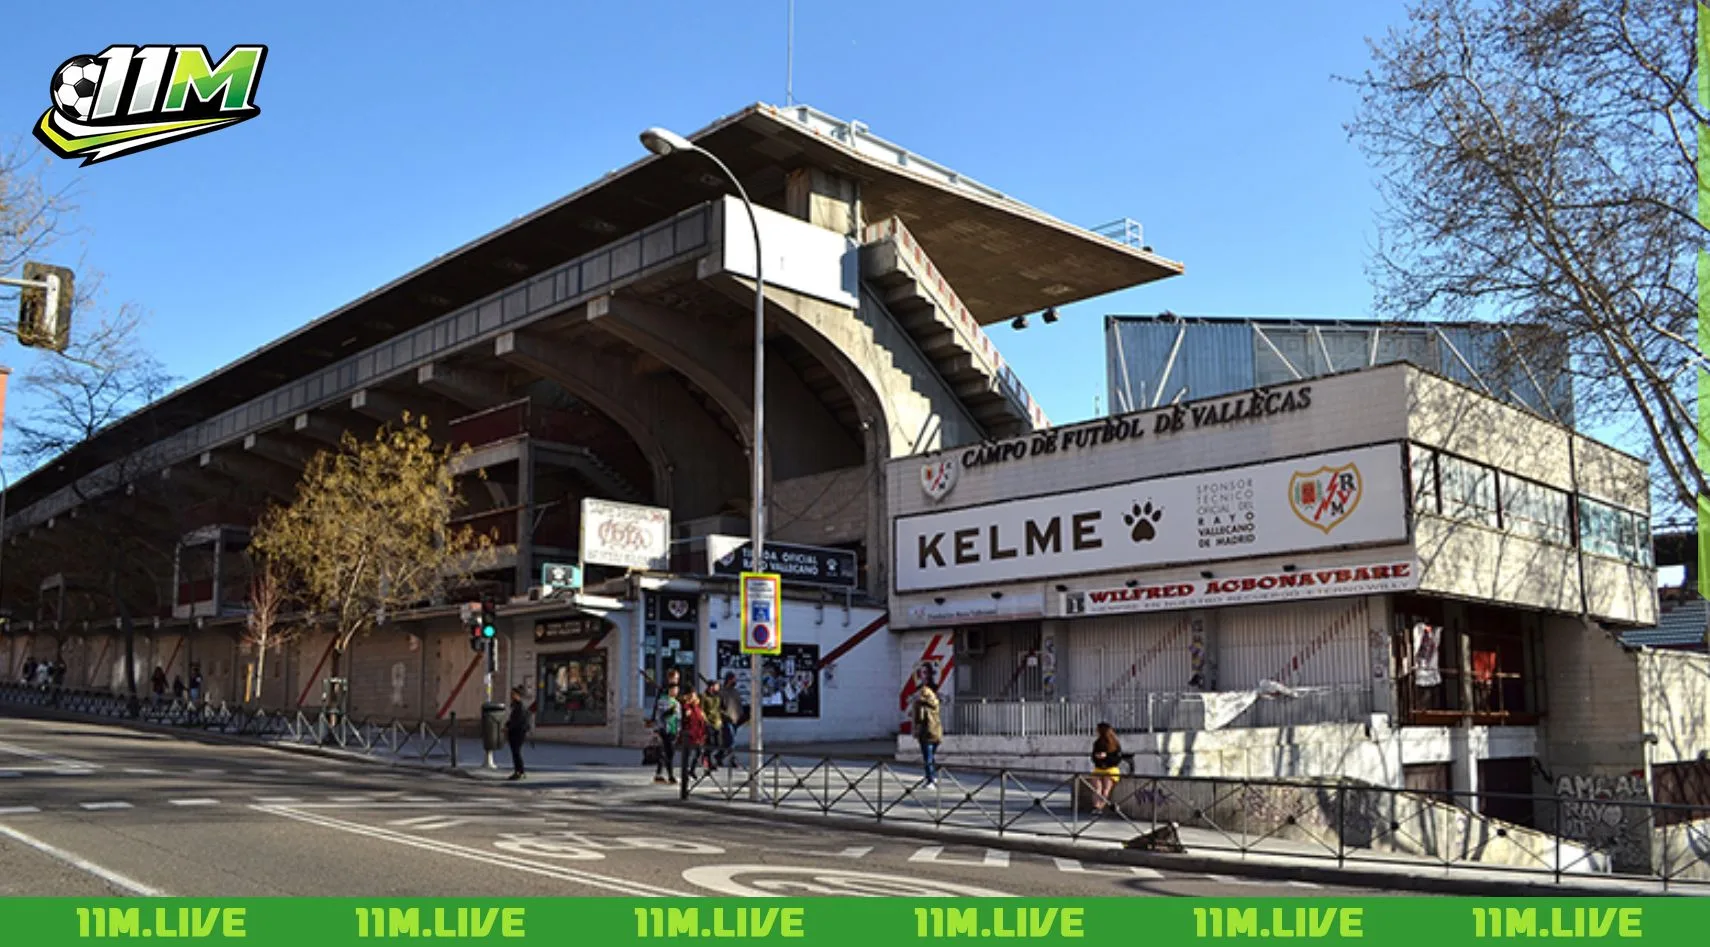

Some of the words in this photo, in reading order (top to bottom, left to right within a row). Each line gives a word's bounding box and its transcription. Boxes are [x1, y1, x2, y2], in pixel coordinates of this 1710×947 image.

[962, 437, 1027, 469] CAMPO
[1031, 434, 1058, 456] DE
[1061, 417, 1145, 450] FUTBOL
[1154, 409, 1186, 434] DE
[1191, 386, 1312, 428] VALLECAS
[1197, 522, 1256, 537] VALLECANO
[918, 510, 1103, 569] KELME
[1198, 538, 1211, 548] DE
[1215, 533, 1257, 546] MADRID
[742, 547, 778, 560] TIDA
[782, 551, 818, 565] OFICIAL
[742, 558, 769, 571] RAO
[1089, 583, 1195, 604] WILFRED
[1205, 563, 1411, 594] AGBONAVBARE
